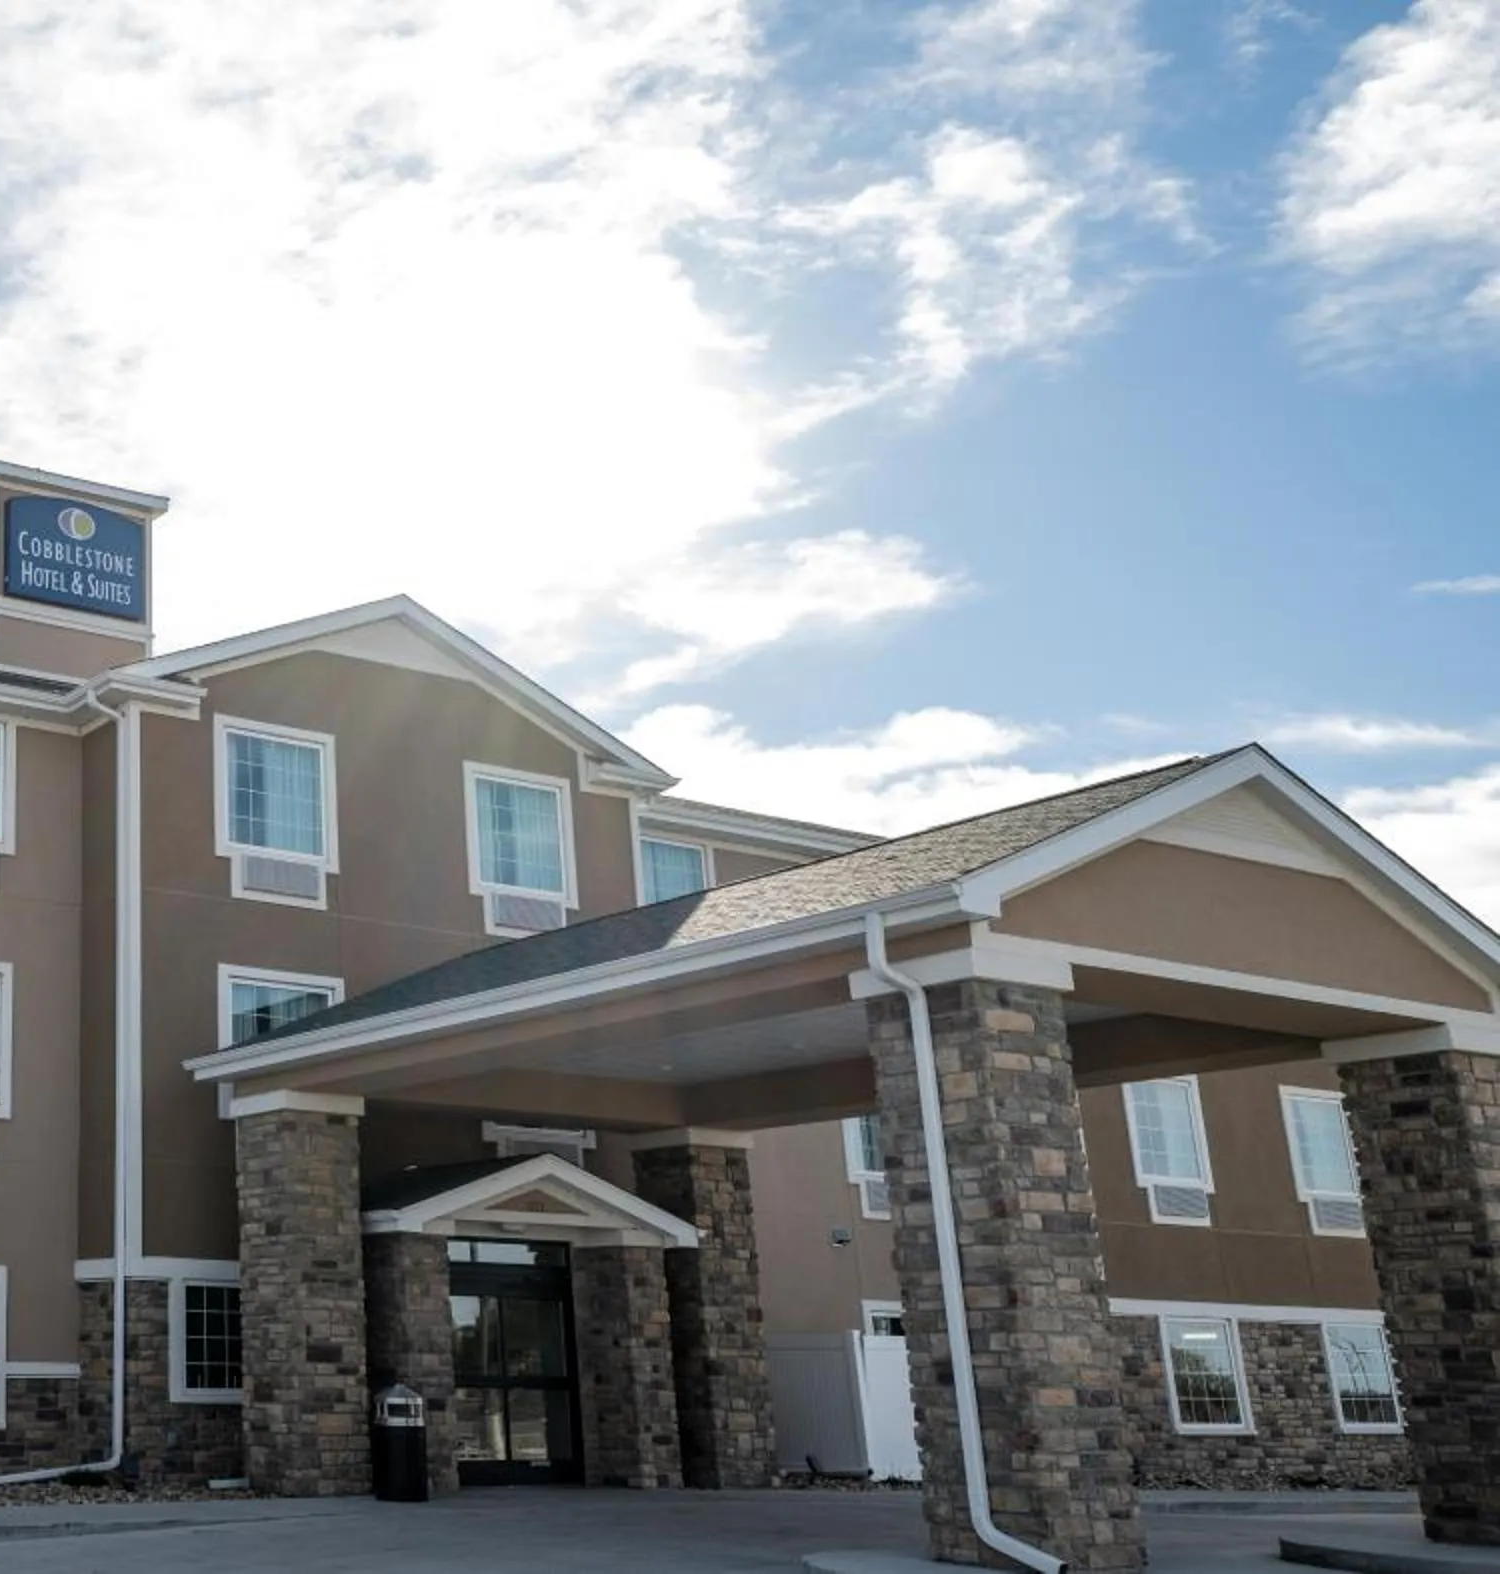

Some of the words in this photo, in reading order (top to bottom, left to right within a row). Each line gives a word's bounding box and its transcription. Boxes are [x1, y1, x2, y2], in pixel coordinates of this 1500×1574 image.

[18, 530, 135, 577] COBBLESTONE
[21, 559, 68, 592] HOTEL
[71, 571, 83, 595] &
[87, 573, 131, 605] SUITES
